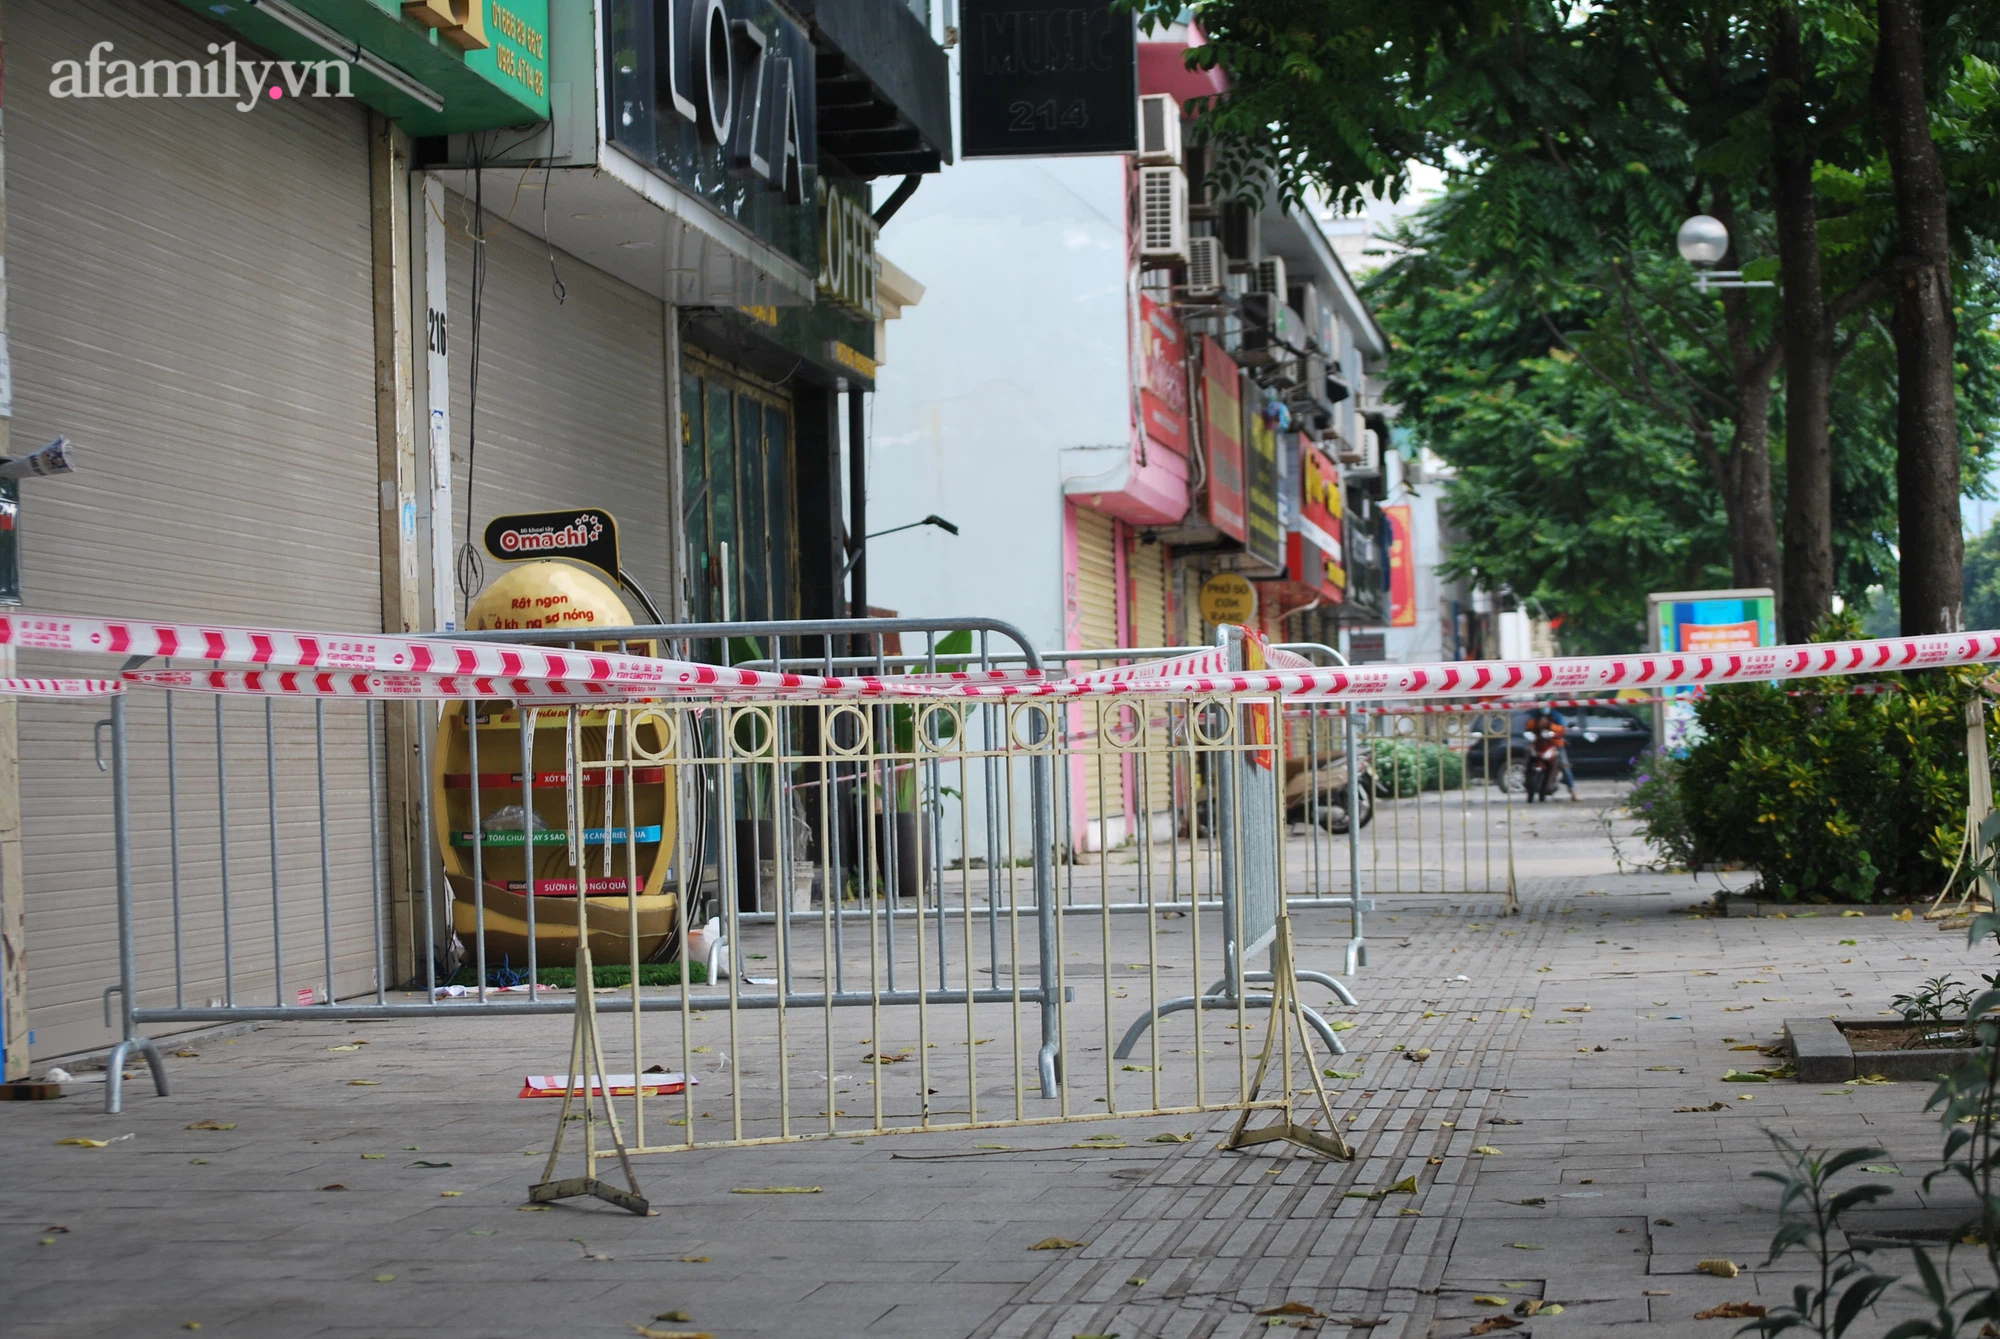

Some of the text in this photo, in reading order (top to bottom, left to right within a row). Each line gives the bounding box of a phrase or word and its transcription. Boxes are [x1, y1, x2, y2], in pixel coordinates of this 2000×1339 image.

[981, 7, 1113, 76] MUSIC
[1008, 99, 1089, 132] 214
[428, 307, 447, 357] 216
[500, 525, 588, 552] Omachi
[535, 595, 568, 608] ngon
[563, 608, 594, 622] nóng
[616, 671, 630, 679] AREA
[550, 833, 565, 841] SAO
